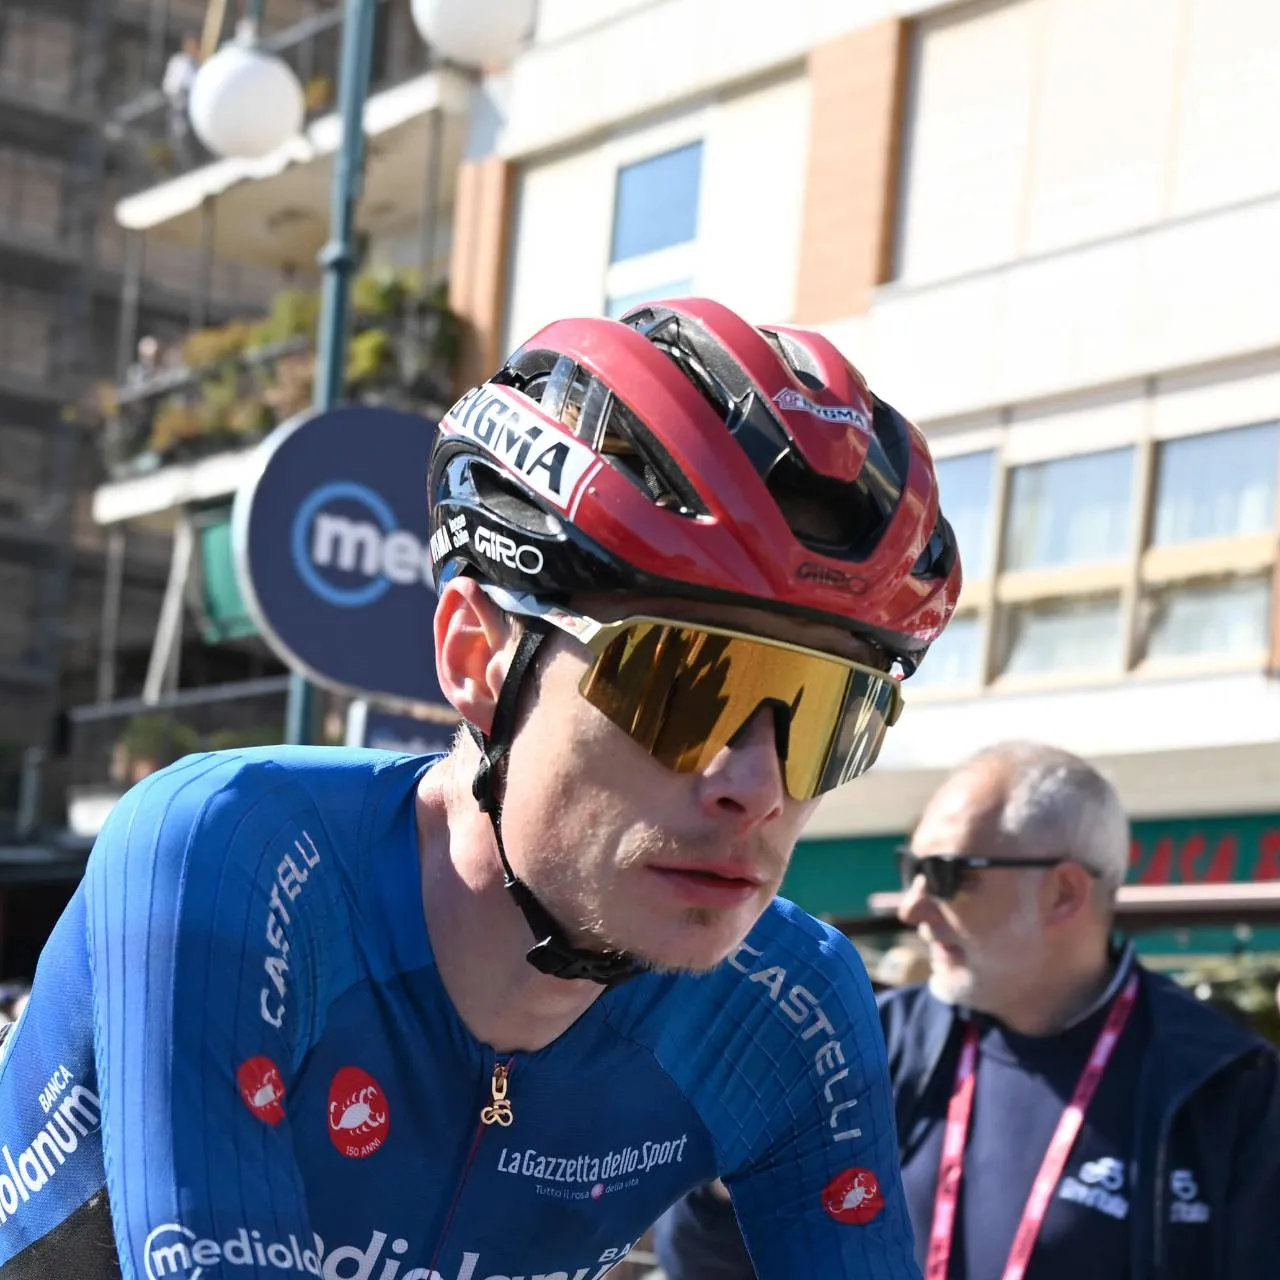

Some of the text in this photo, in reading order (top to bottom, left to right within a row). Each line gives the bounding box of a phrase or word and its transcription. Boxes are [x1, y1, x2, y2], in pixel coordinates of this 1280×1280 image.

[474, 525, 544, 575] GIRO
[796, 561, 867, 596] GIRO
[727, 941, 863, 1143] CASTELLI
[38, 1064, 74, 1114] BANCA
[346, 1137, 381, 1157] 150 ANNI
[637, 1133, 688, 1173] Sport
[536, 1184, 562, 1199] Tutto
